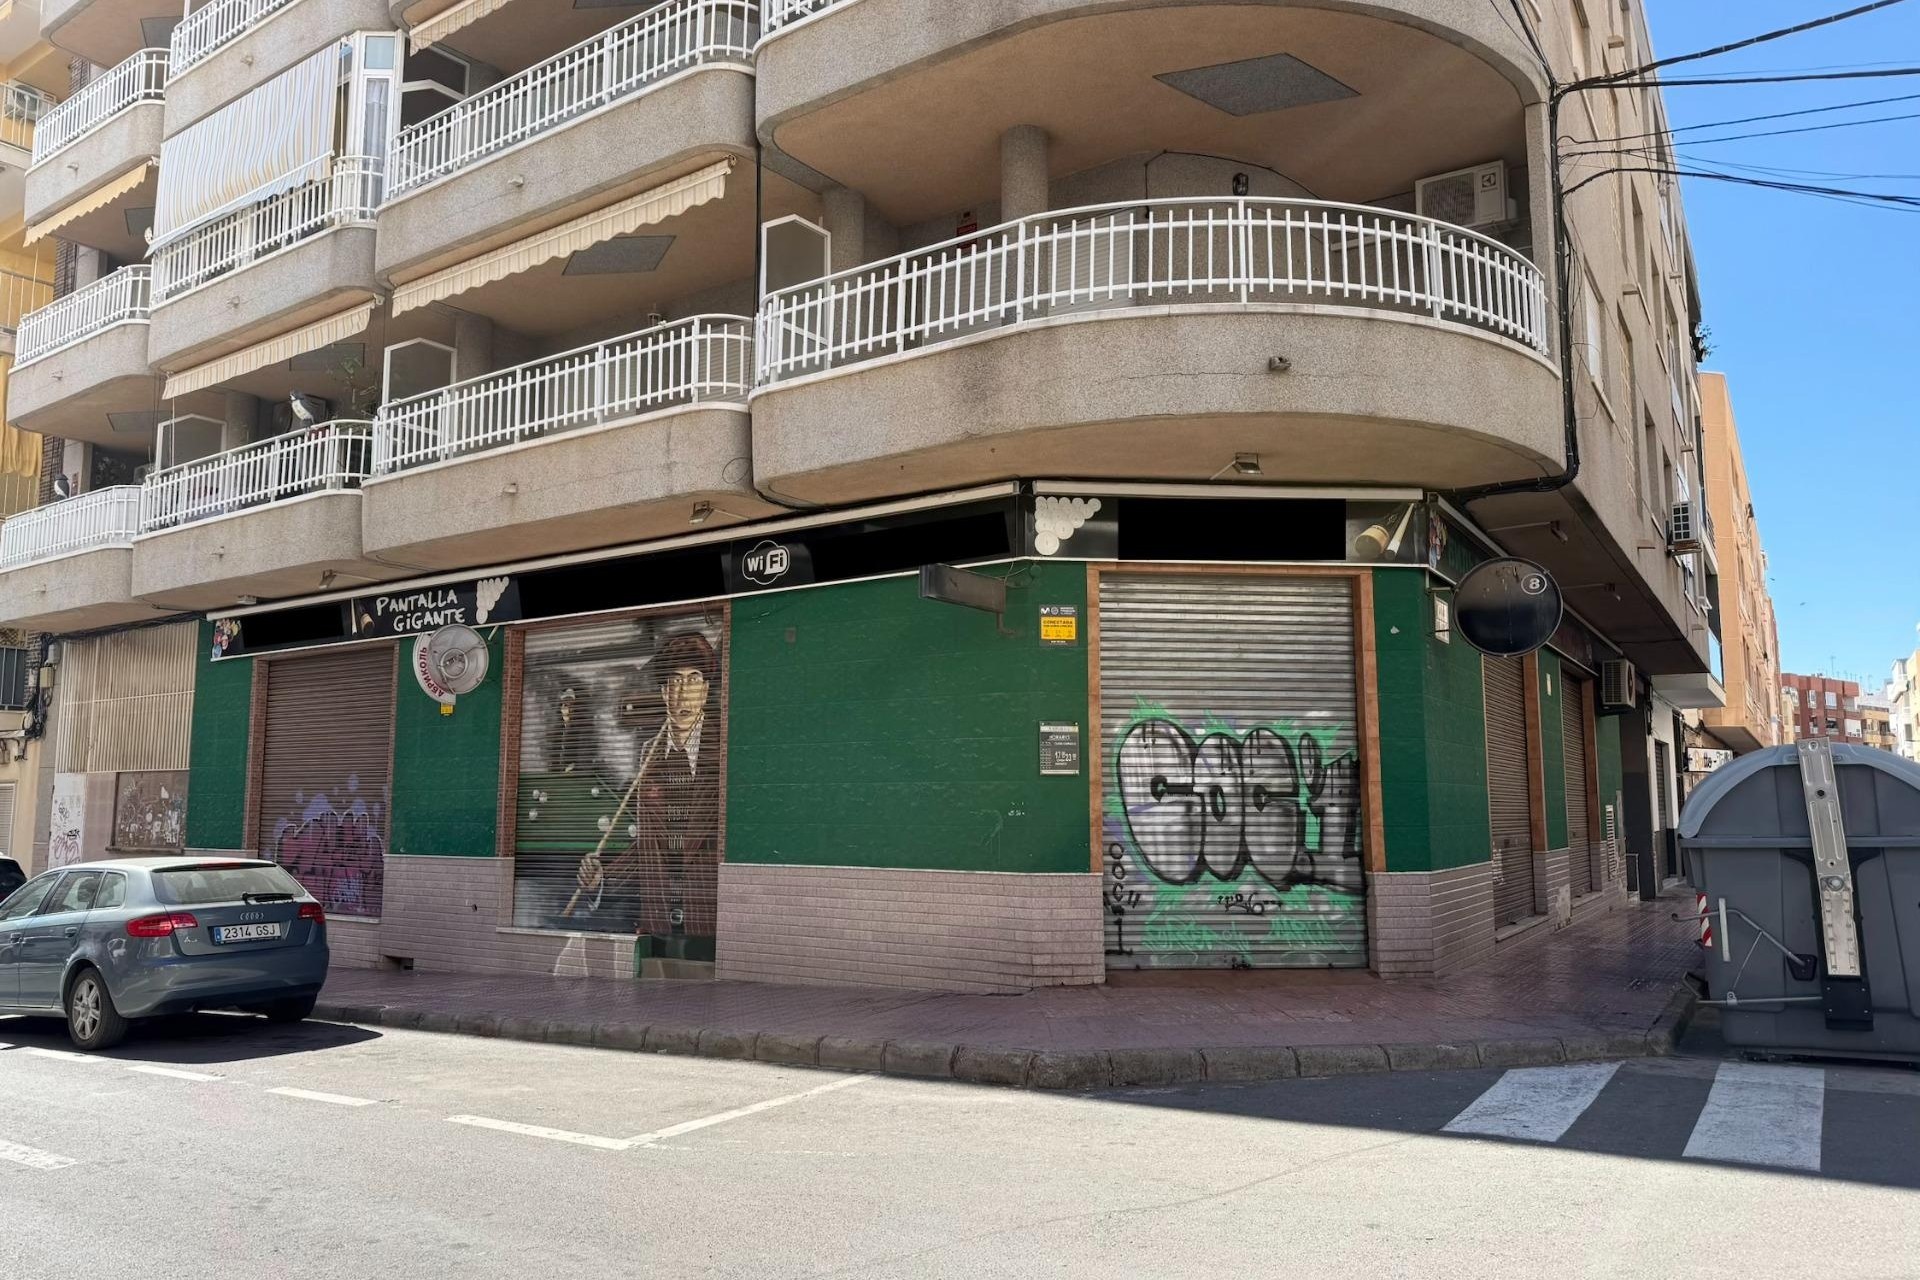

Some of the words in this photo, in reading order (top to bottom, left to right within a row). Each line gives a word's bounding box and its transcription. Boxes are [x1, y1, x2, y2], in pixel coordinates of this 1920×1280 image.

[1529, 577, 1541, 589] 8
[376, 589, 458, 616] PANTALLA
[419, 646, 445, 698] АБРИКОЛЬ
[223, 925, 252, 938] 2314
[255, 923, 277, 936] GSJ
